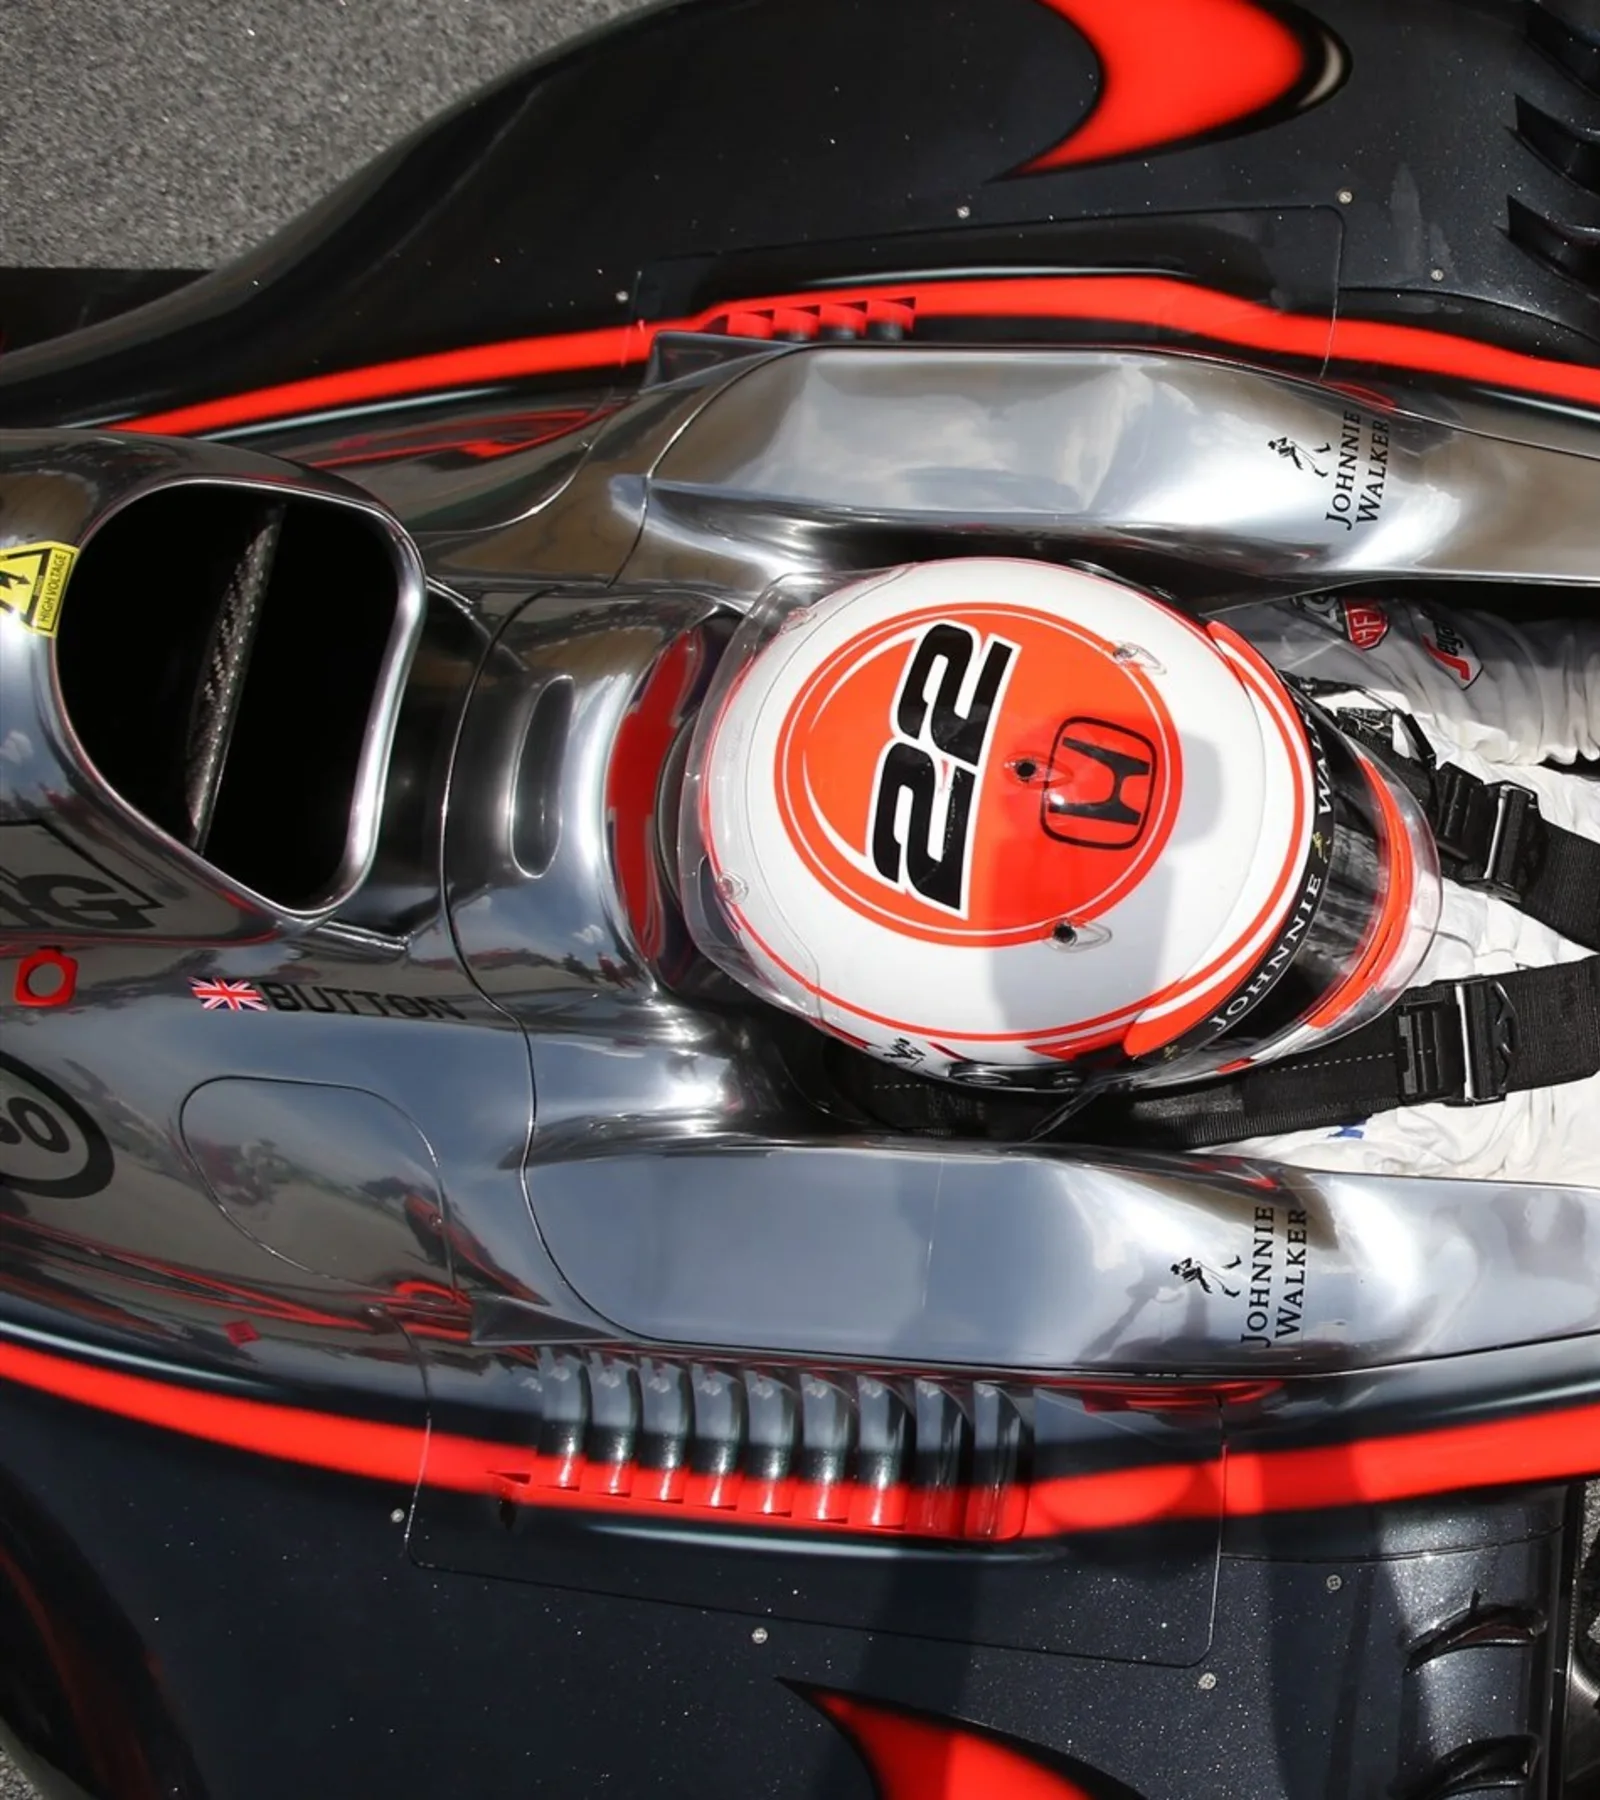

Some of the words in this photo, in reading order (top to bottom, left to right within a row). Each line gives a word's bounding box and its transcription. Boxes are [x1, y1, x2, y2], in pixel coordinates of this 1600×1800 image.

[1325, 411, 1361, 531] JOHNNIE
[1355, 420, 1389, 522] WALKER
[44, 553, 67, 596] VOLTAGE
[871, 623, 1014, 911] 22
[259, 982, 467, 1020] BUTTON
[1208, 873, 1321, 1032] JOHNNIE
[1240, 1205, 1275, 1348] JOHNNIE
[1275, 1209, 1308, 1339] WALKER
